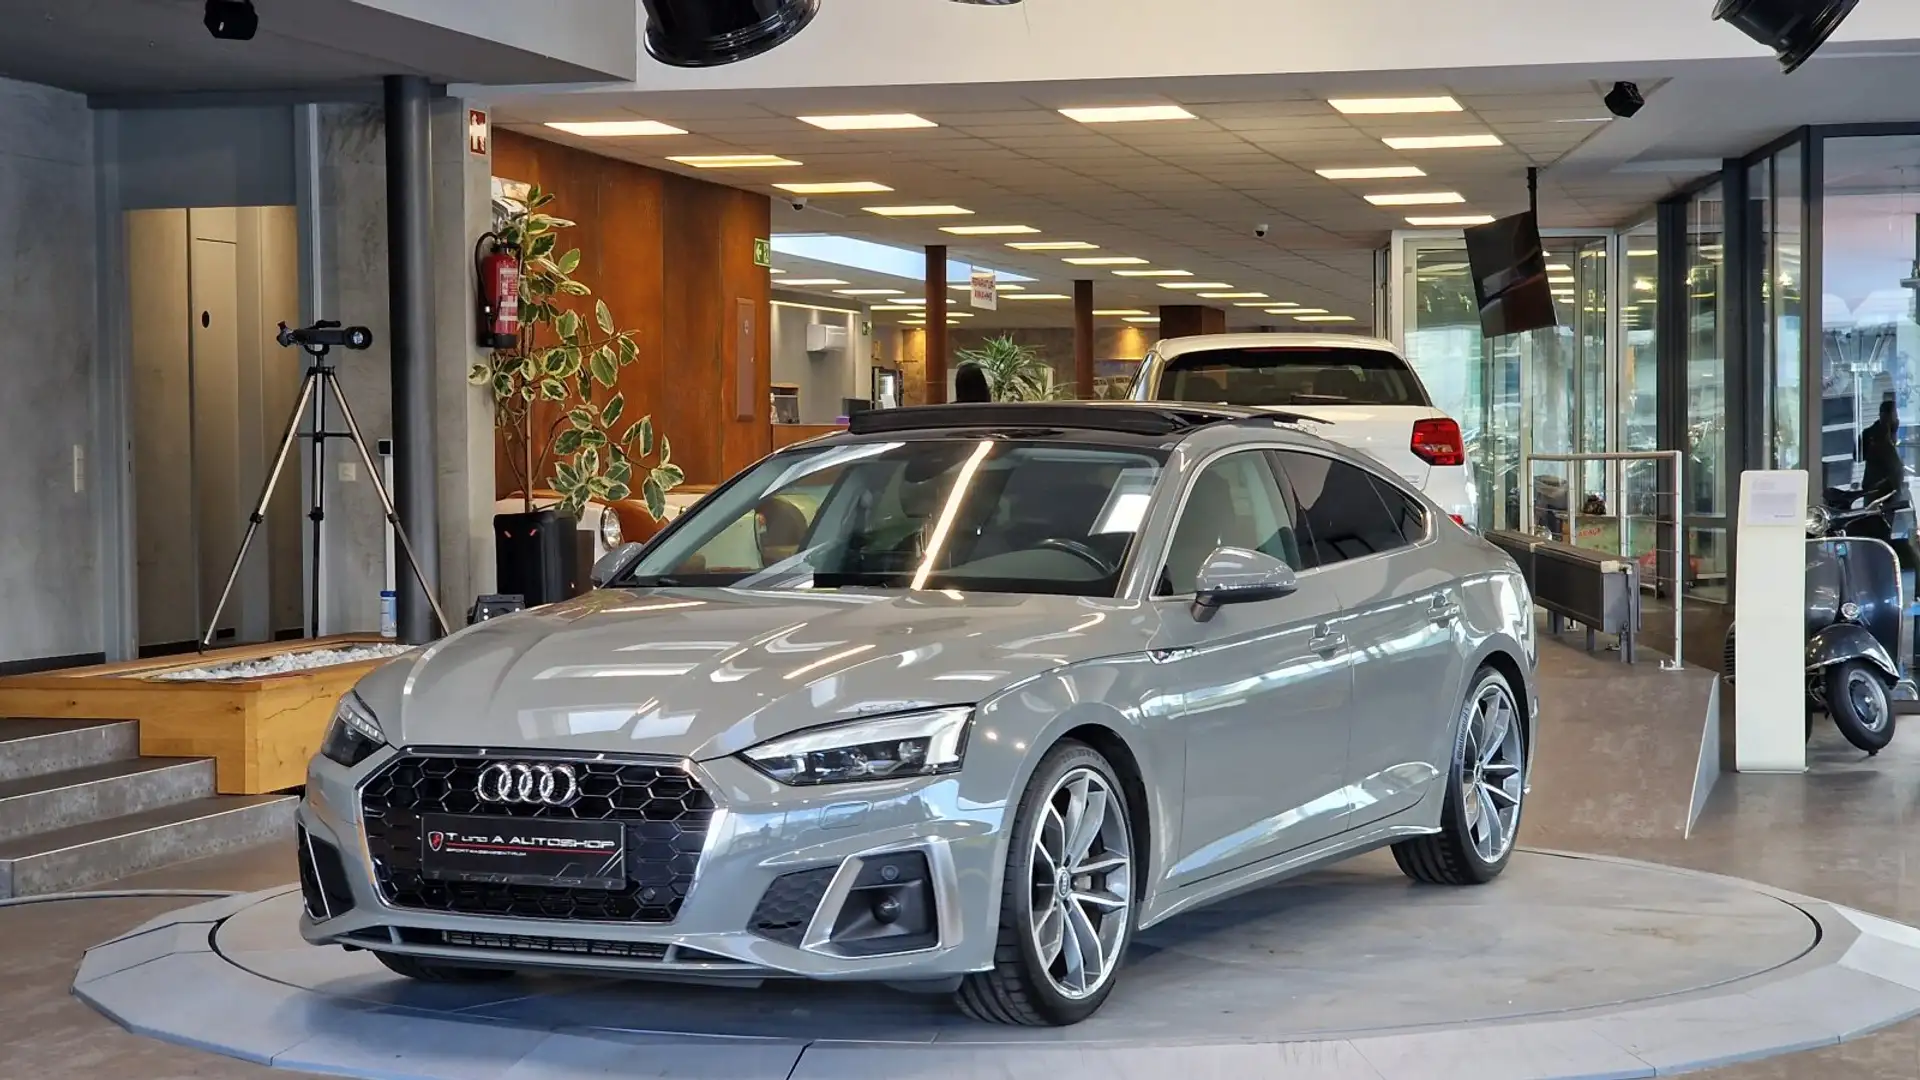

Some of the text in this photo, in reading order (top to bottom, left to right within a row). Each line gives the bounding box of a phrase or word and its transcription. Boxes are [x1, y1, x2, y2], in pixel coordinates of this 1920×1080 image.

[445, 832, 459, 841] T
[491, 835, 505, 844] A
[508, 836, 616, 849] AUTOSHOP
